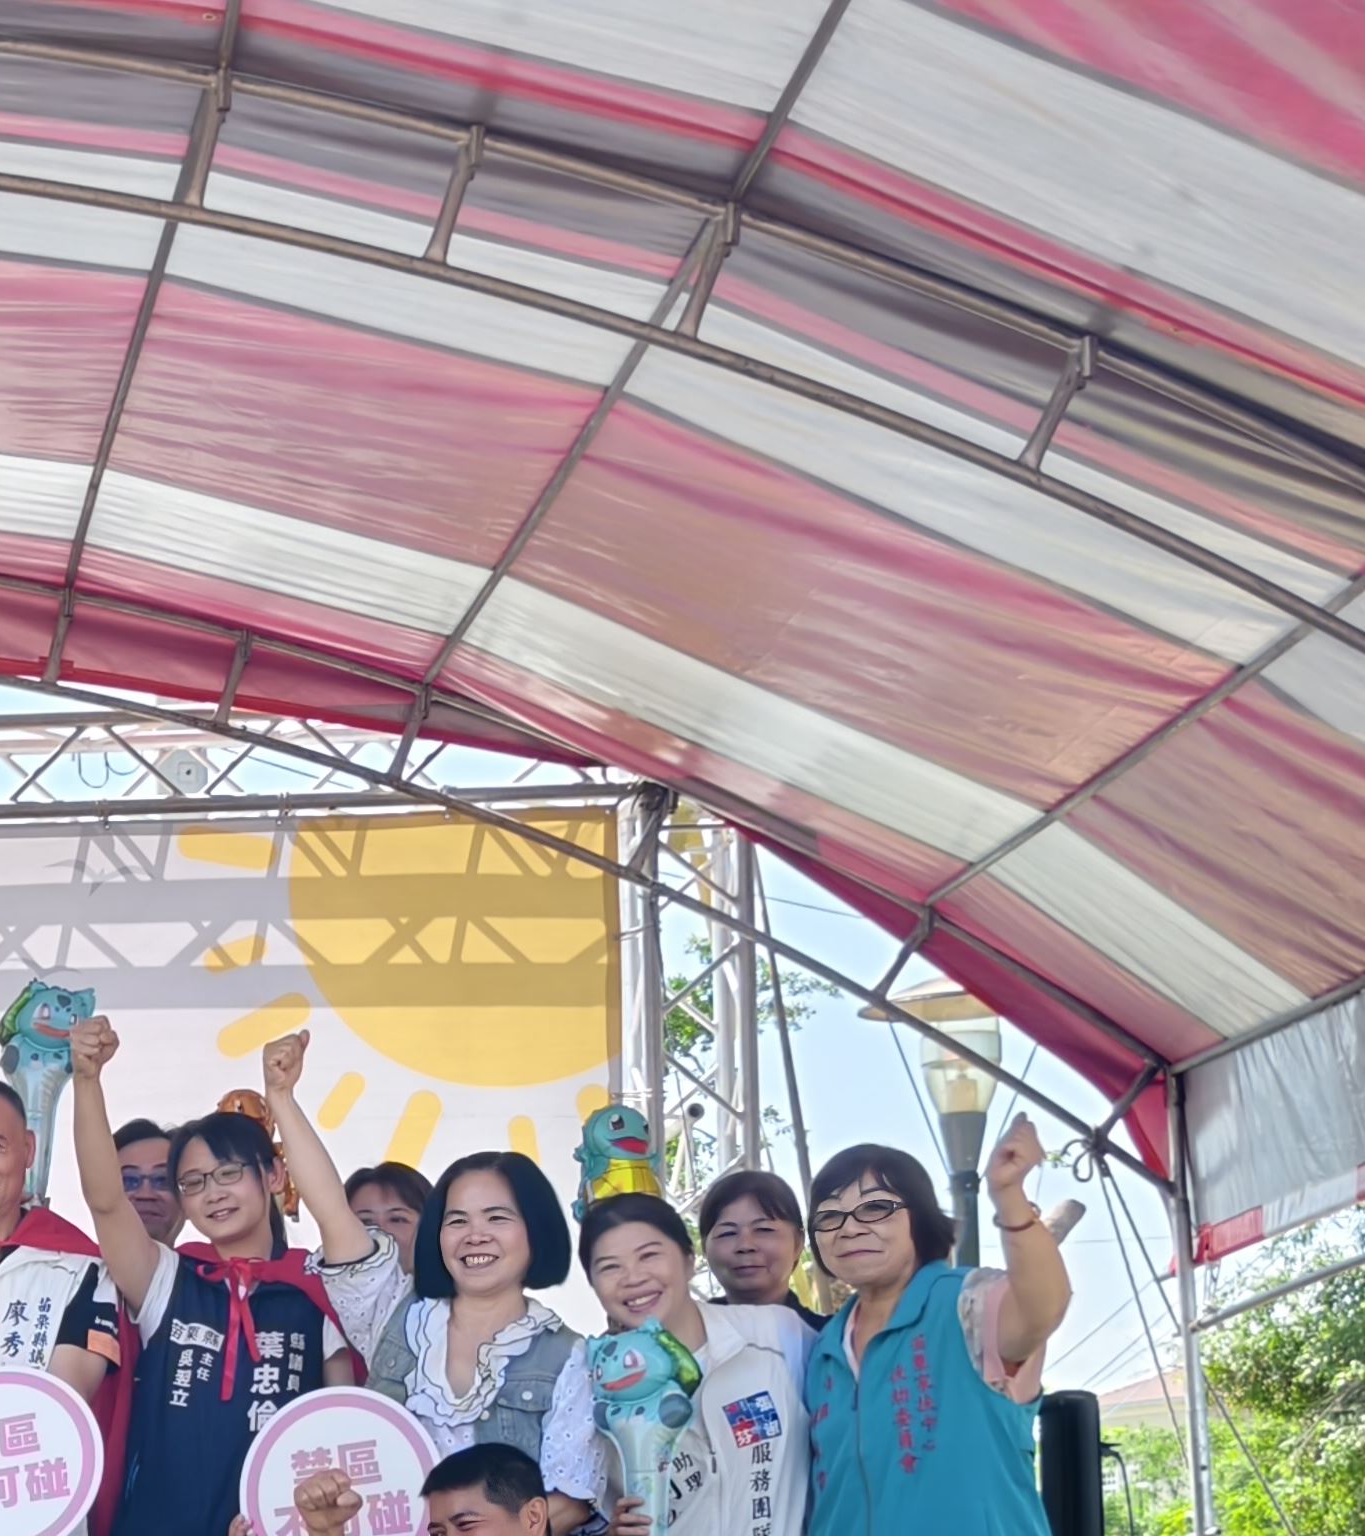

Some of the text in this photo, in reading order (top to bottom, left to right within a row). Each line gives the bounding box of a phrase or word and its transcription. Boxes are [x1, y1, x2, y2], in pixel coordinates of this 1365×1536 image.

[28, 1297, 52, 1370] 苗栗縣議
[285, 1332, 306, 1393] 縣議員
[196, 1351, 215, 1382] 主任
[247, 1331, 285, 1432] 葉忠倫
[671, 1451, 703, 1493] 助理
